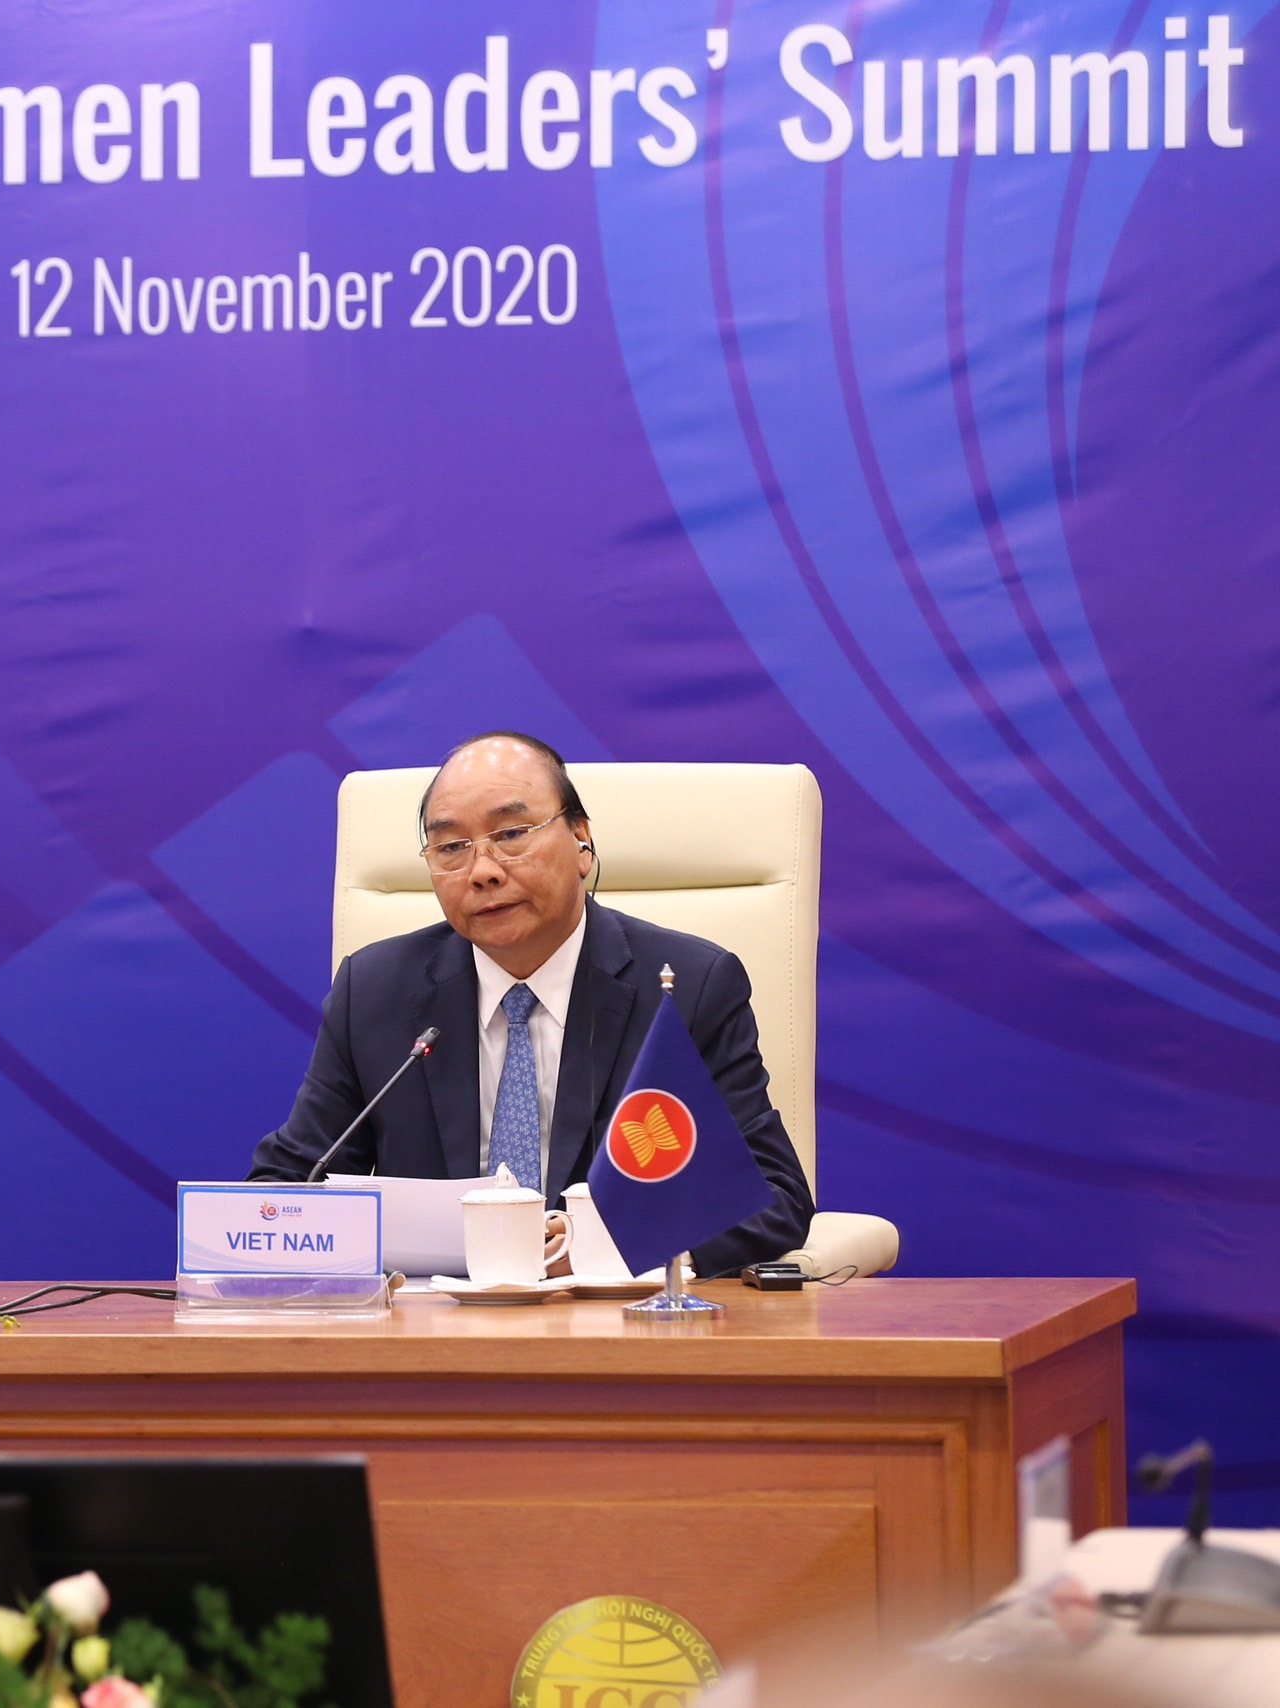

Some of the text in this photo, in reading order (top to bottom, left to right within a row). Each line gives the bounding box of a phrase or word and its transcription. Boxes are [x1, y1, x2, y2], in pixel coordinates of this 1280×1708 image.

[778, 14, 1245, 163] Summit
[10, 243, 578, 338] 12 November 2020
[226, 1232, 334, 1252] VIET NAM
[521, 1627, 561, 1678] TRUNG
[629, 1602, 672, 1633] NGHỊ
